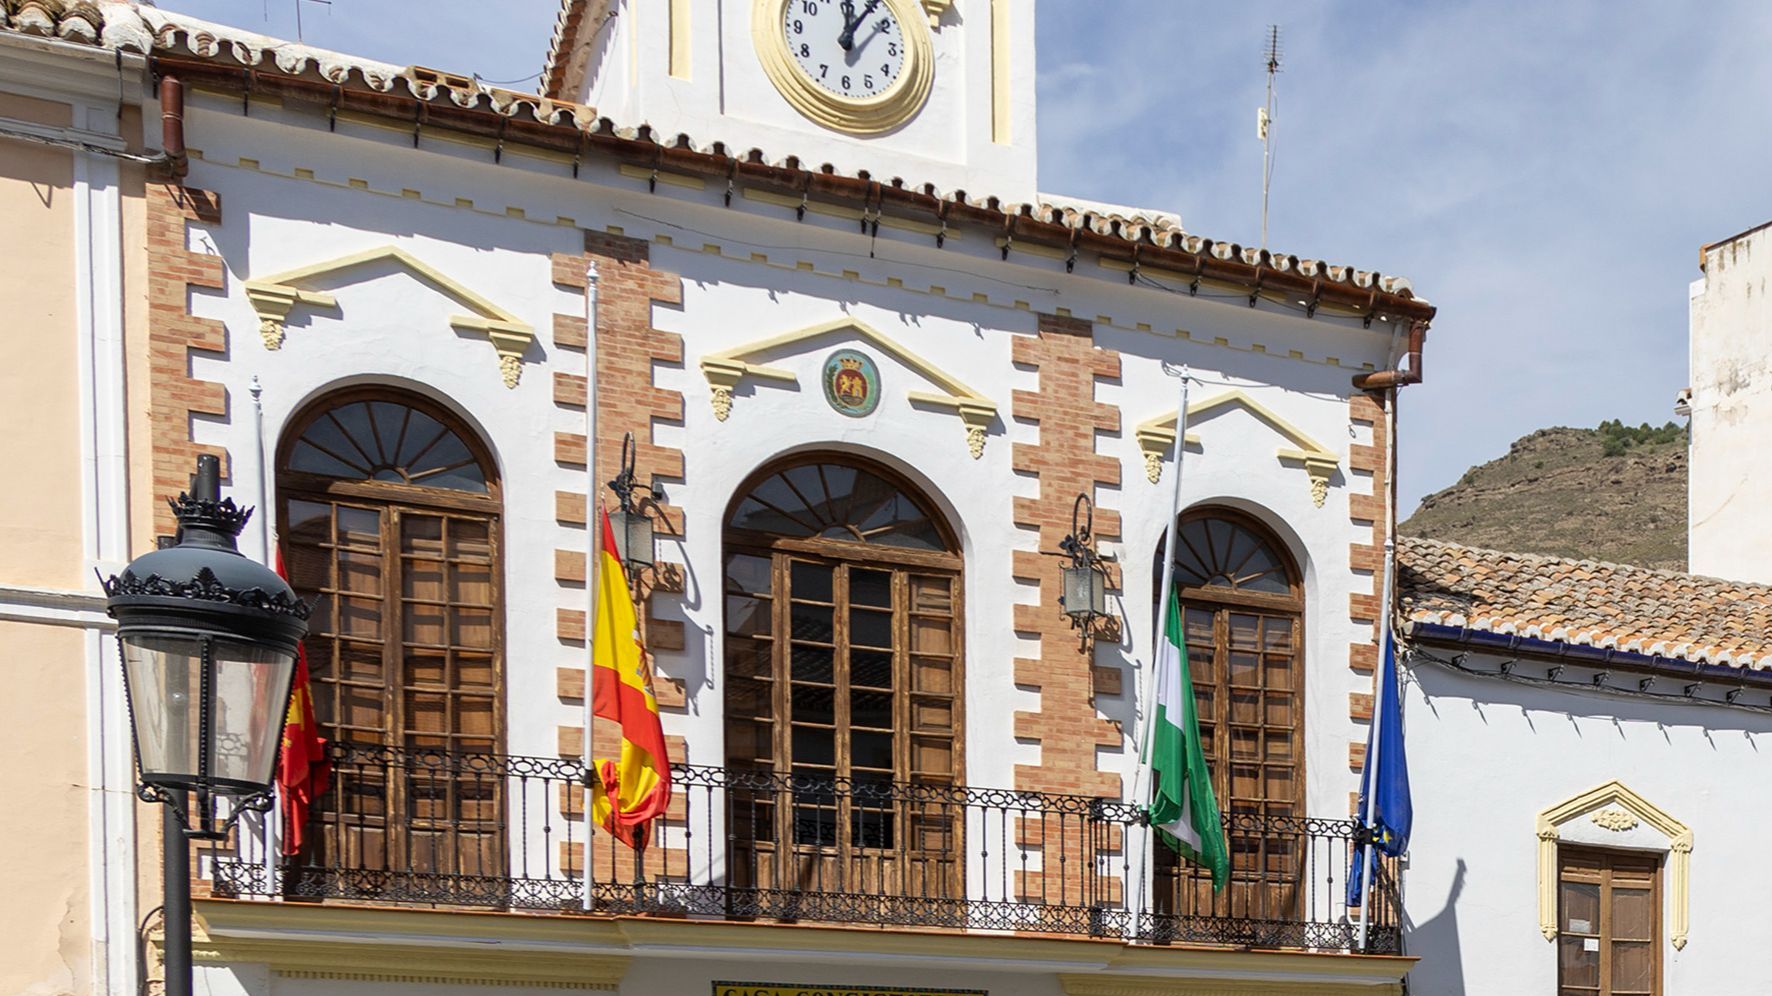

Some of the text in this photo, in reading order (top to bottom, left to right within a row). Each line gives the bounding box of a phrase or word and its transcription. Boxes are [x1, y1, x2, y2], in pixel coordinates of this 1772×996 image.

[793, 20, 803, 34] 9
[880, 19, 890, 34] 2
[801, 43, 810, 58] 8
[888, 42, 897, 57] 3
[819, 64, 828, 78] 7
[881, 64, 890, 77] 4
[842, 75, 851, 90] 6
[864, 74, 873, 89] 5
